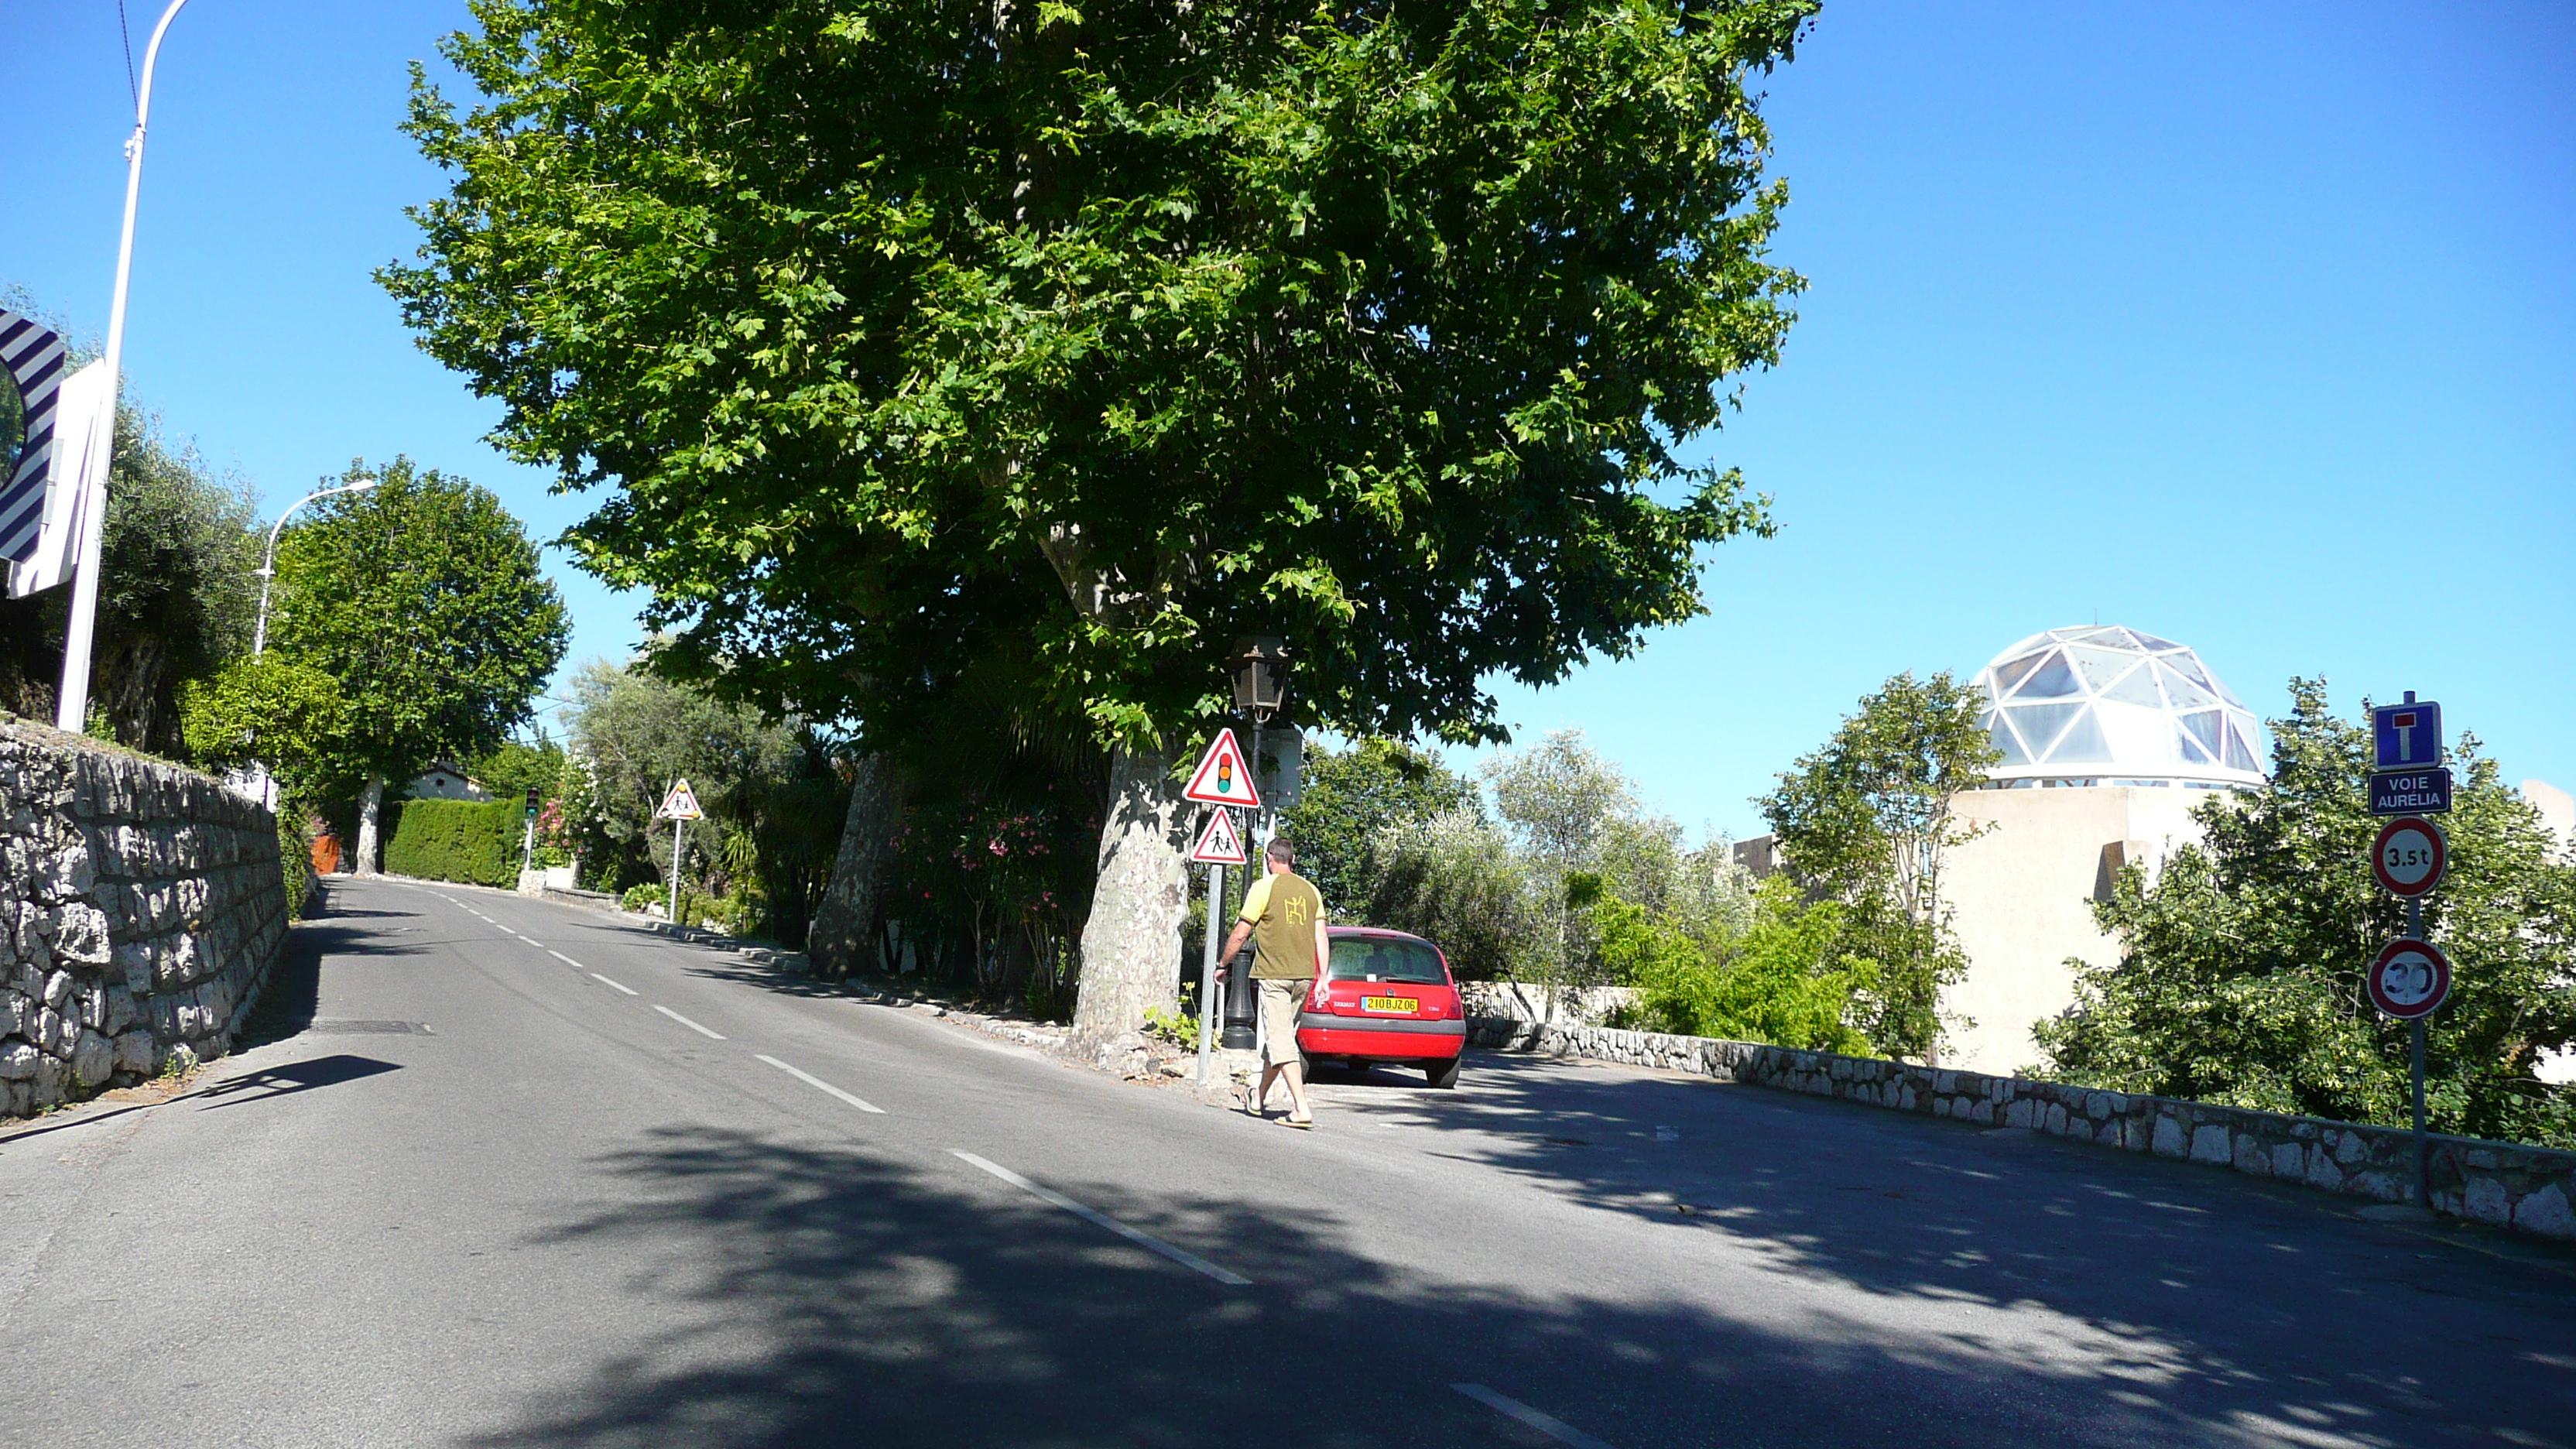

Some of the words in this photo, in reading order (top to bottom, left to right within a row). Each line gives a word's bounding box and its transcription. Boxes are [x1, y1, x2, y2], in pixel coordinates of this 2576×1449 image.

[2389, 776, 2428, 790] VOIE
[2378, 790, 2441, 808] AURÉLIA
[1368, 999, 1385, 1009] 210
[1404, 1000, 1416, 1010] 06
